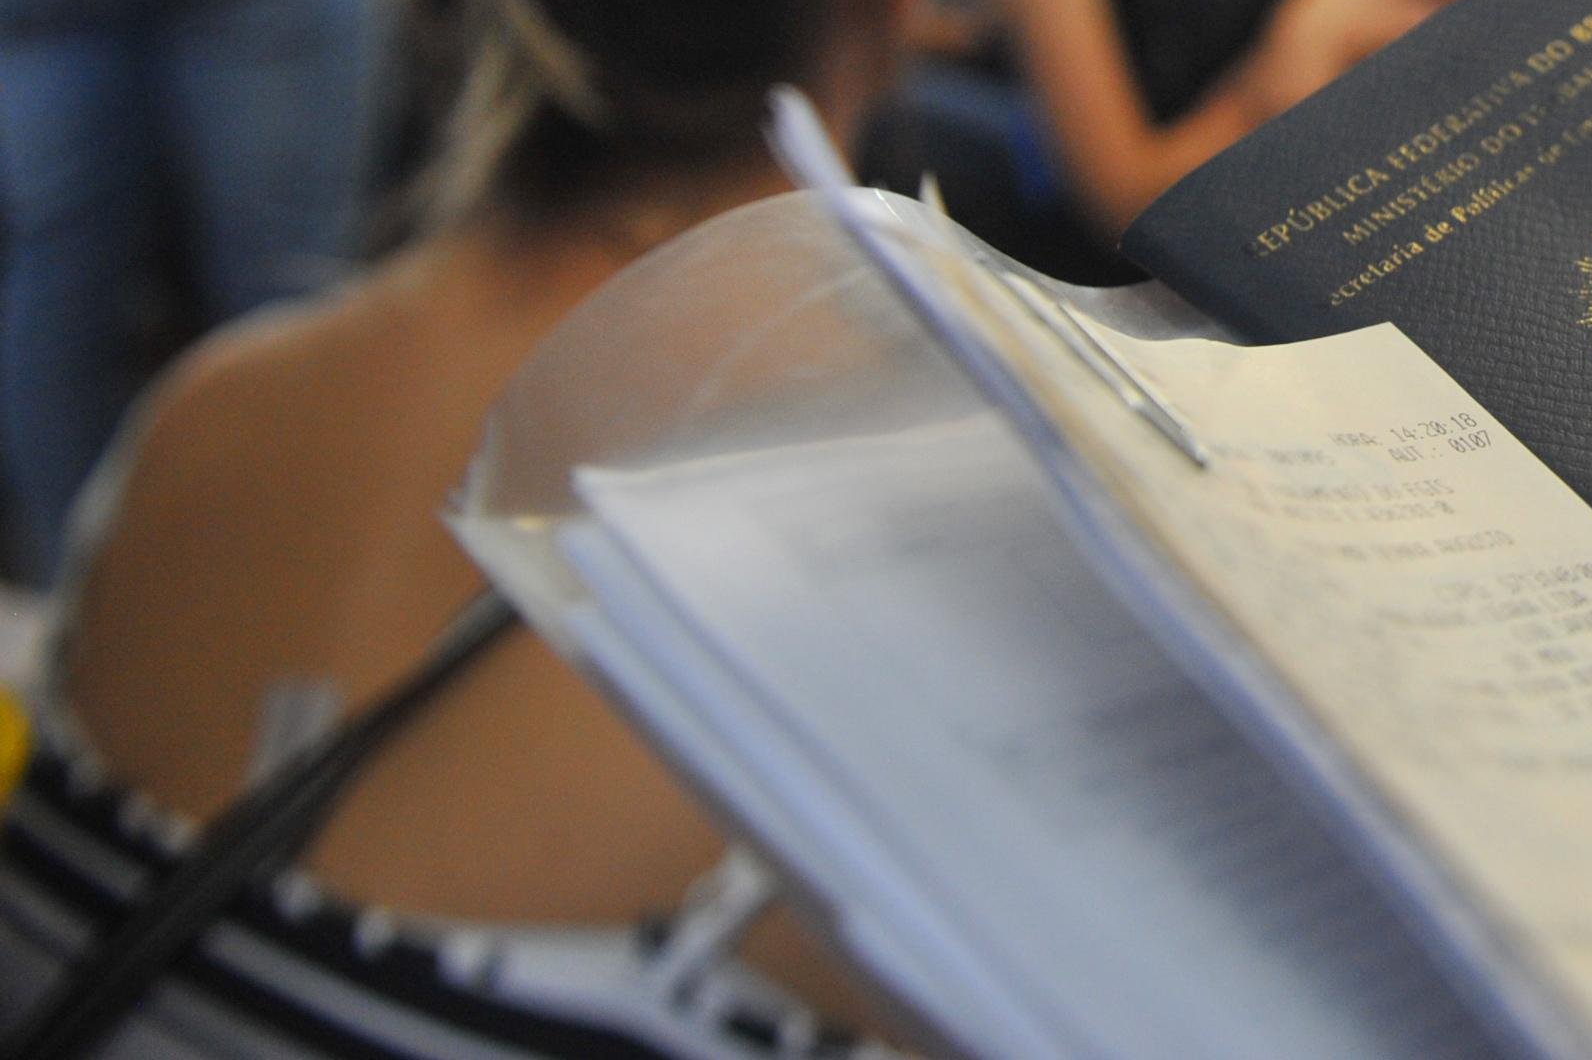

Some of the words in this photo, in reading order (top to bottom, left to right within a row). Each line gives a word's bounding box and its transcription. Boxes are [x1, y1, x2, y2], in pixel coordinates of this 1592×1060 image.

[1253, 165, 1389, 258] EPÚBLICA
[1531, 35, 1572, 81] DO
[1340, 148, 1482, 247] MINISTÉRIO
[1481, 121, 1521, 159] DO
[1330, 240, 1425, 306] ecretaria
[1425, 216, 1454, 245] de
[1450, 163, 1536, 228] Políticas
